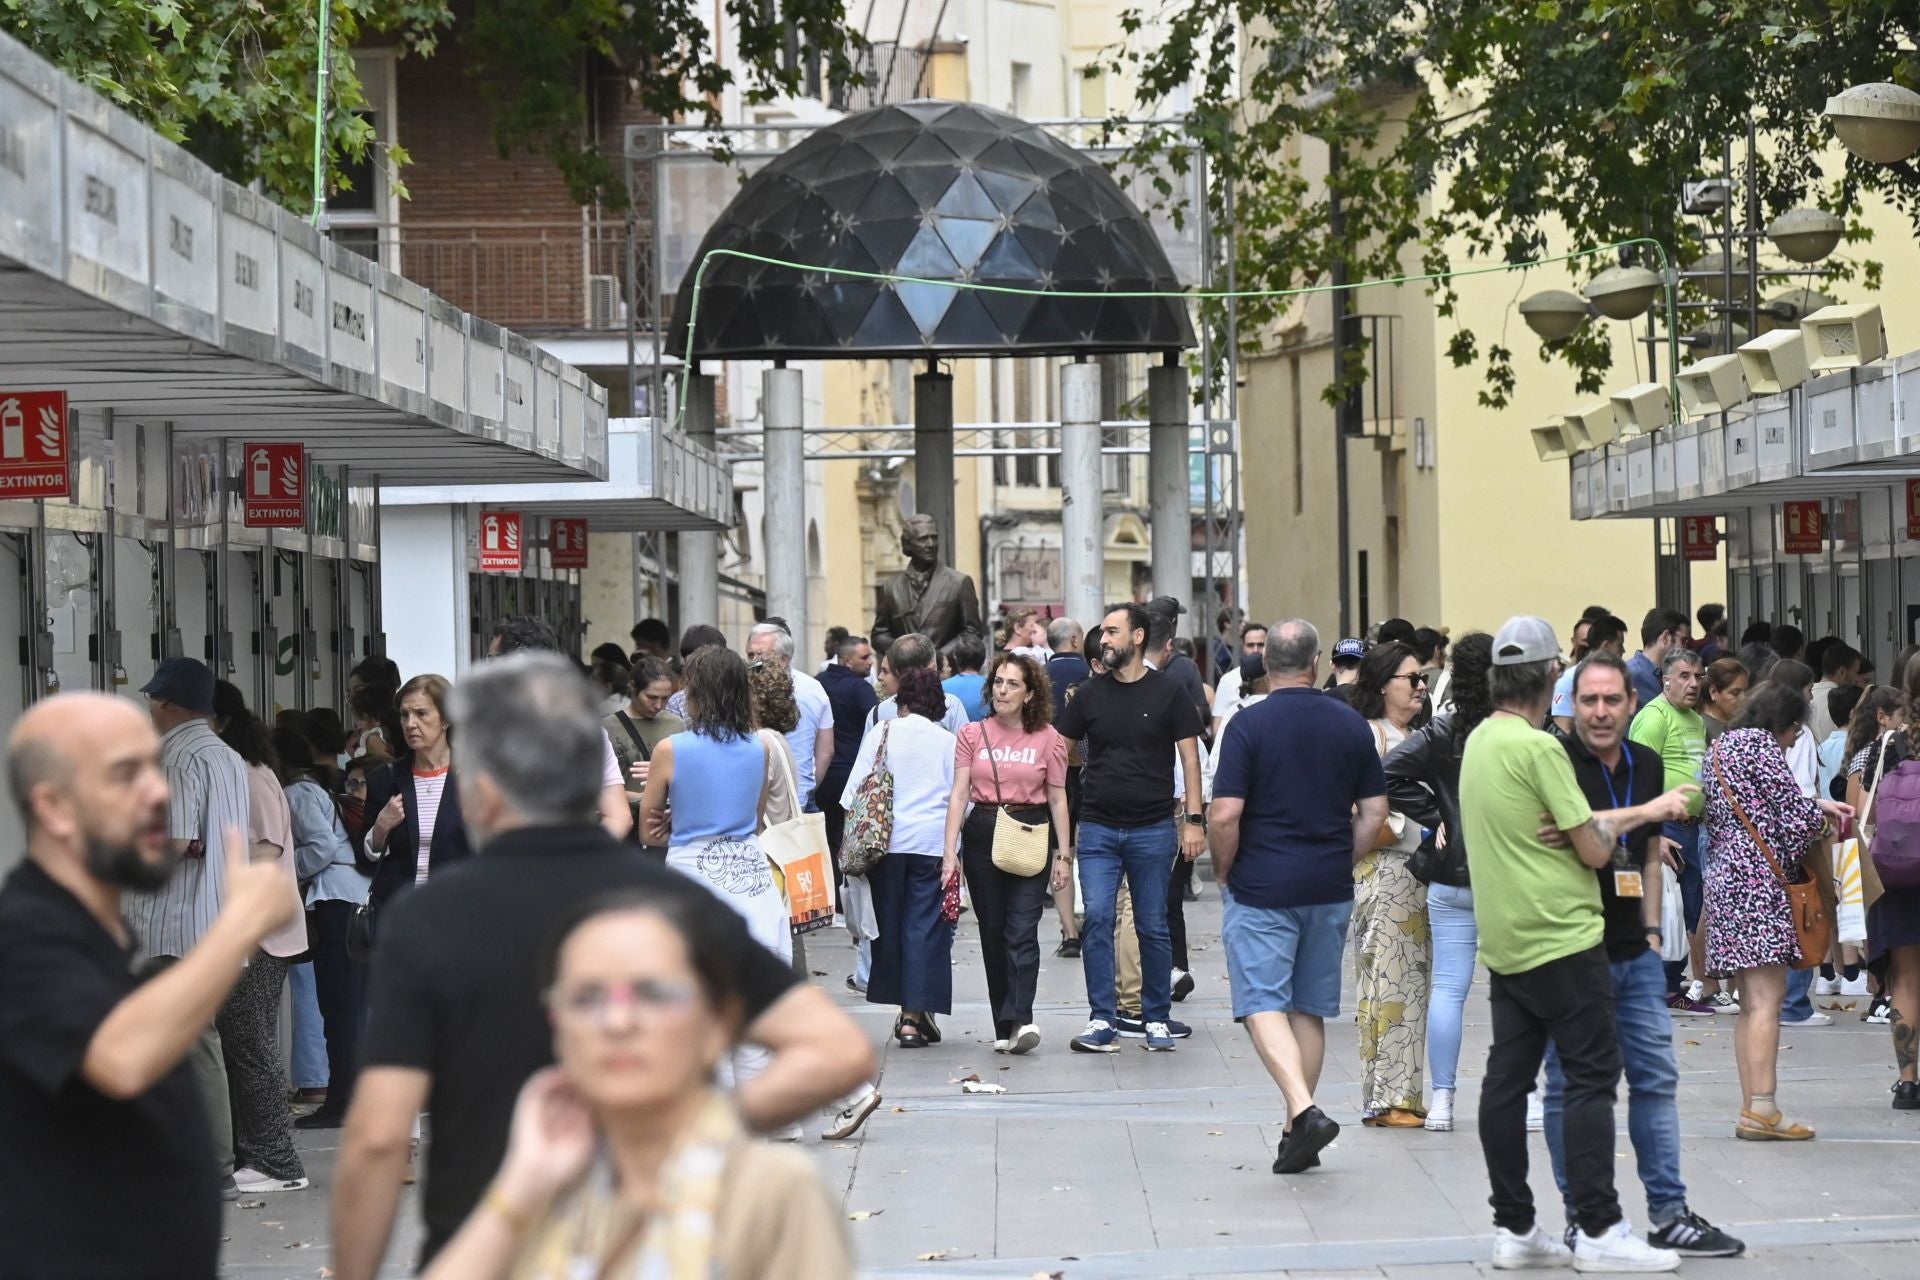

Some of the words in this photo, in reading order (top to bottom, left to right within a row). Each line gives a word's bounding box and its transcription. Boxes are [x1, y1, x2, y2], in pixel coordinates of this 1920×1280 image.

[0, 474, 64, 488] EXTINTOR
[249, 508, 300, 519] EXTINTOR
[483, 557, 518, 566] EXTINTOR
